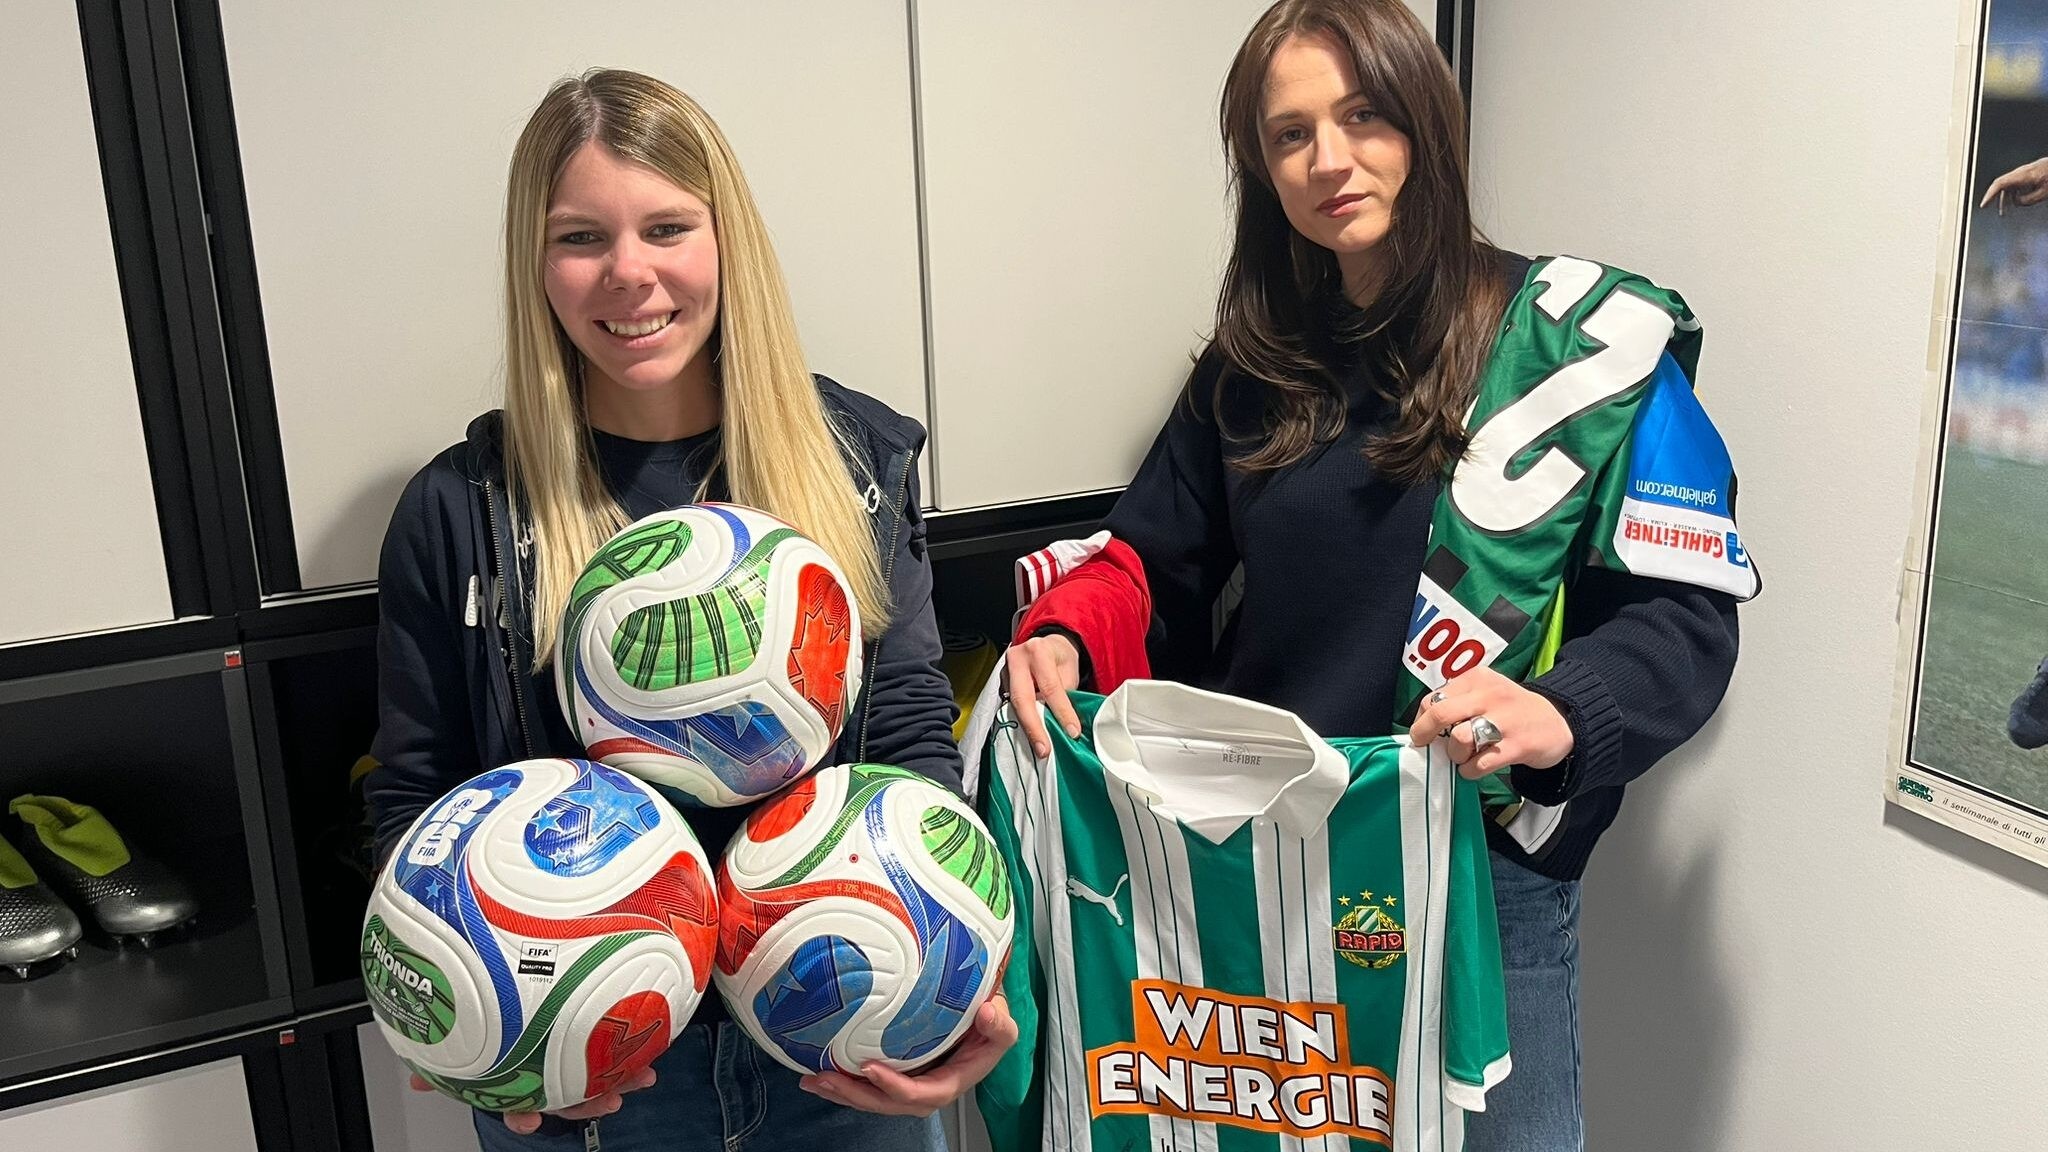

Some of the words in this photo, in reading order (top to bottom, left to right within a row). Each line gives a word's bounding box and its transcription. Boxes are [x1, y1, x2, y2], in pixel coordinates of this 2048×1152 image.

[1636, 479, 1717, 507] gahleitner.com
[1222, 753, 1262, 766] RE:FIBRE
[1942, 798, 1949, 806] il
[1951, 802, 1999, 827] settimanale
[2002, 822, 2011, 831] di
[2013, 826, 2032, 839] tutti
[2034, 834, 2047, 845] gli
[418, 846, 436, 857] FIFA
[1338, 931, 1402, 951] RAPID
[370, 929, 433, 996] TRIONDA
[1143, 988, 1338, 1064] WIEN
[1098, 1051, 1393, 1139] ENERGIE
